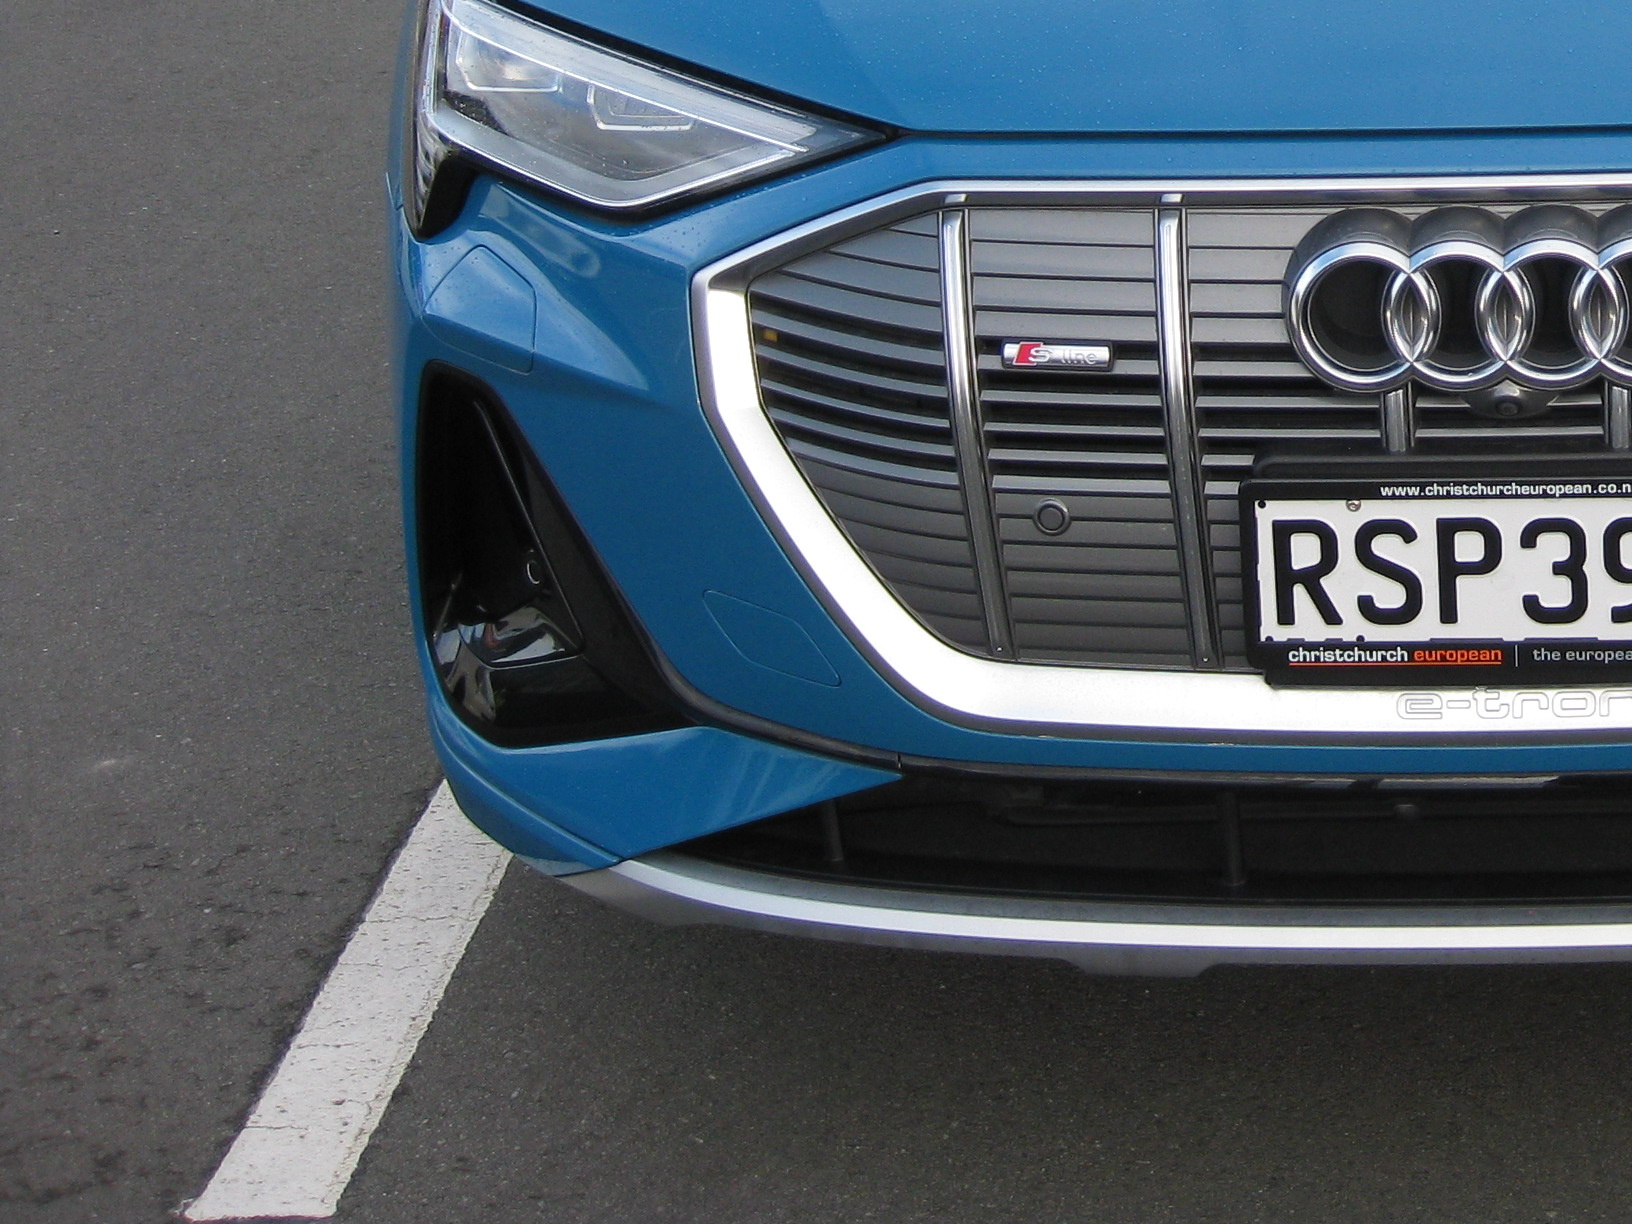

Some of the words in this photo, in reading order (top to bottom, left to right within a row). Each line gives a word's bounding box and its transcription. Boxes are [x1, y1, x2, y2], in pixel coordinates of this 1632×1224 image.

[1288, 646, 1408, 663] christchurch
[1413, 647, 1502, 665] european
[1532, 647, 1562, 661] the
